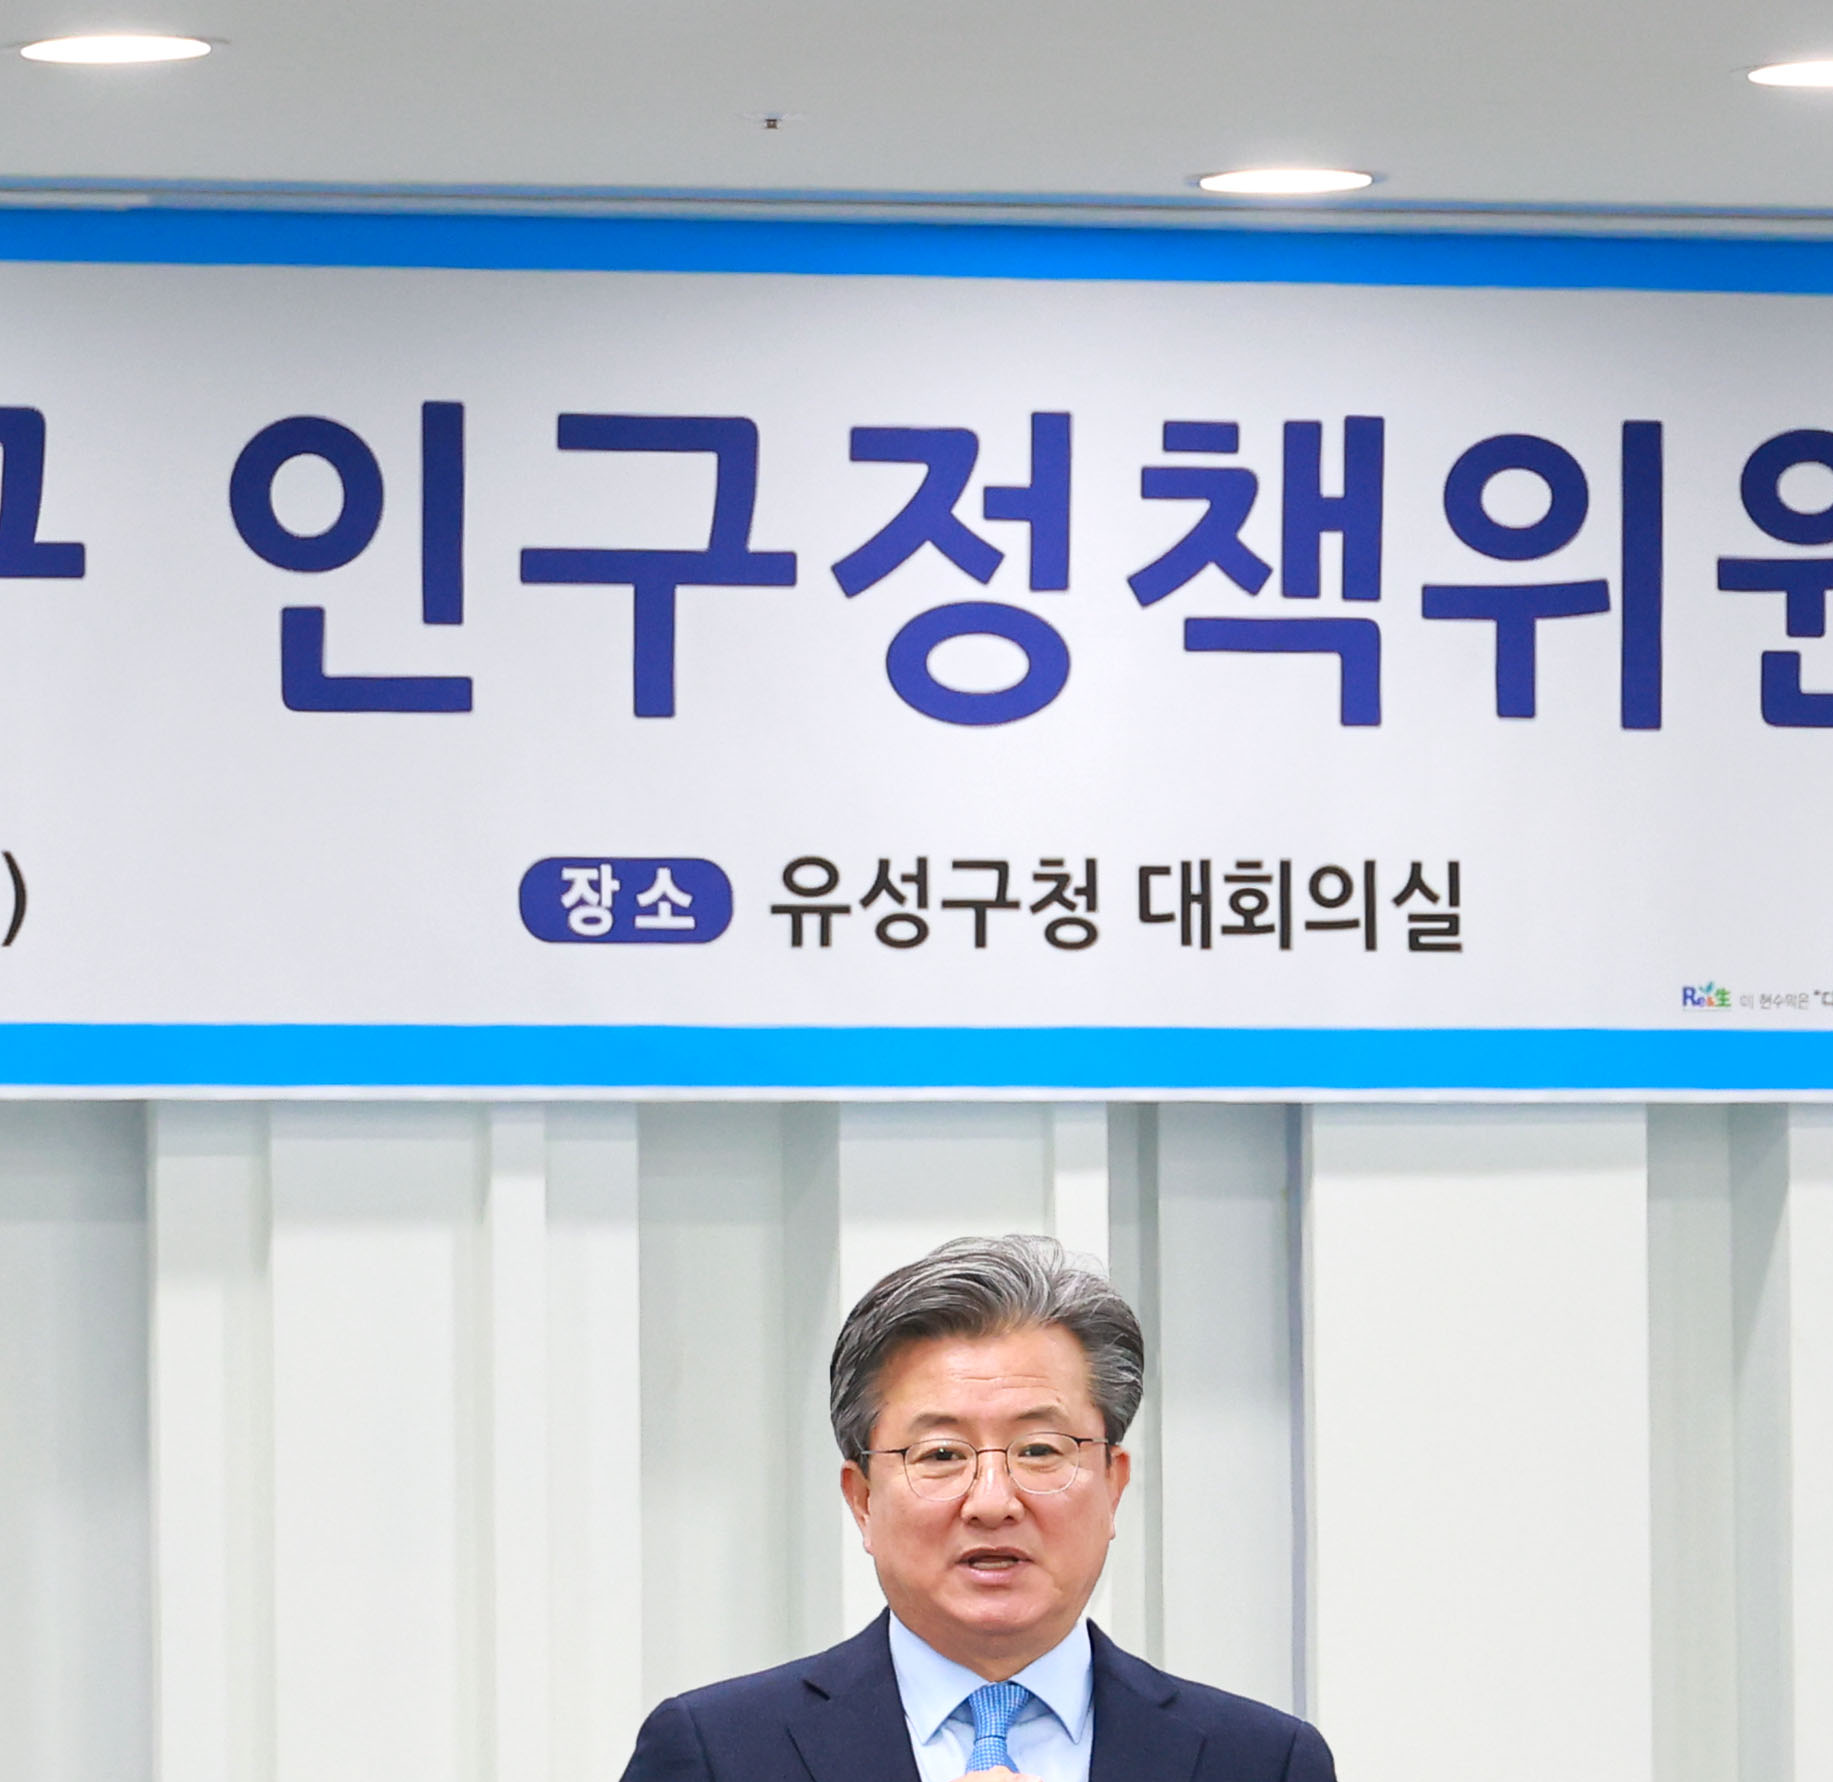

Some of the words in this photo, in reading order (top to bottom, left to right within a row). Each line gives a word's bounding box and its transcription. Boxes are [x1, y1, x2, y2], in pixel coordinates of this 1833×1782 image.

[559, 859, 696, 936] 장소
[770, 854, 1103, 951] 유성구청
[1136, 857, 1464, 953] 대회의실
